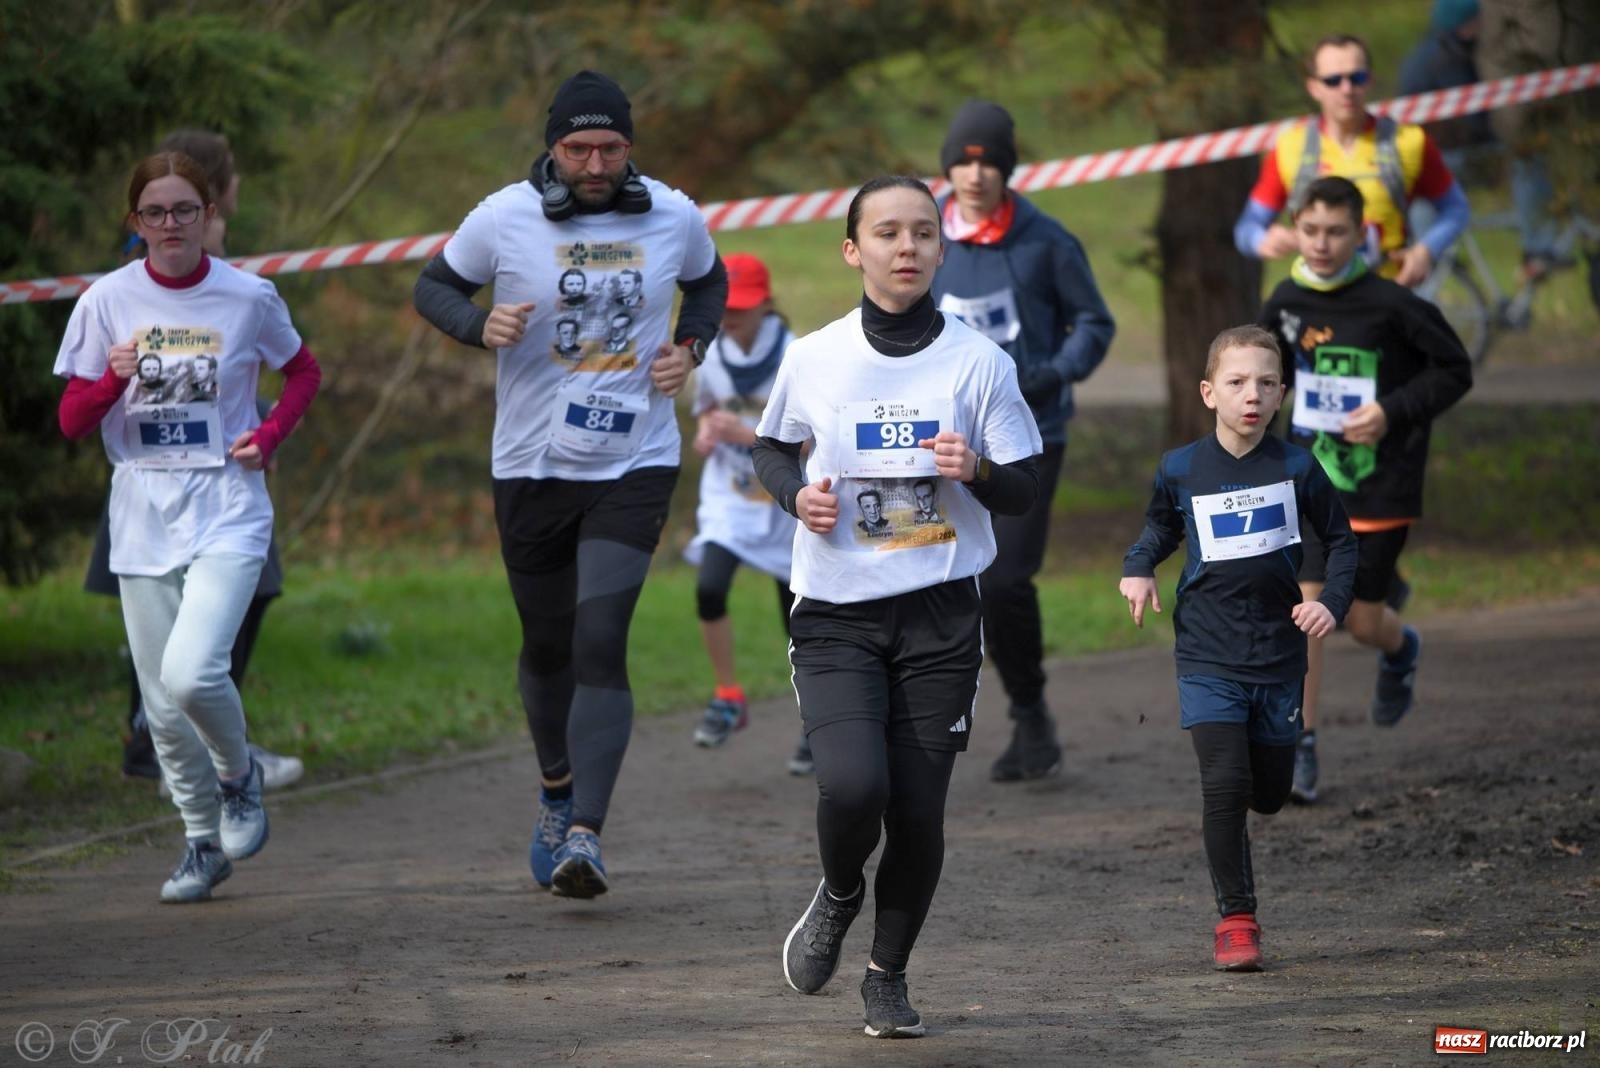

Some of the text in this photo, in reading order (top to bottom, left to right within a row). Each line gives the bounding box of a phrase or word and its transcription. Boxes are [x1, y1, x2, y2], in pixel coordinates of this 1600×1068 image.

[168, 335, 210, 346] WILCZYM
[1319, 391, 1344, 412] 55
[585, 409, 615, 431] 84
[888, 408, 919, 417] WILCZYM
[158, 423, 187, 444] 34
[880, 422, 915, 448] 98
[1237, 495, 1265, 507] WILCZYM
[1237, 510, 1253, 533] 7
[938, 528, 957, 540] 2024
